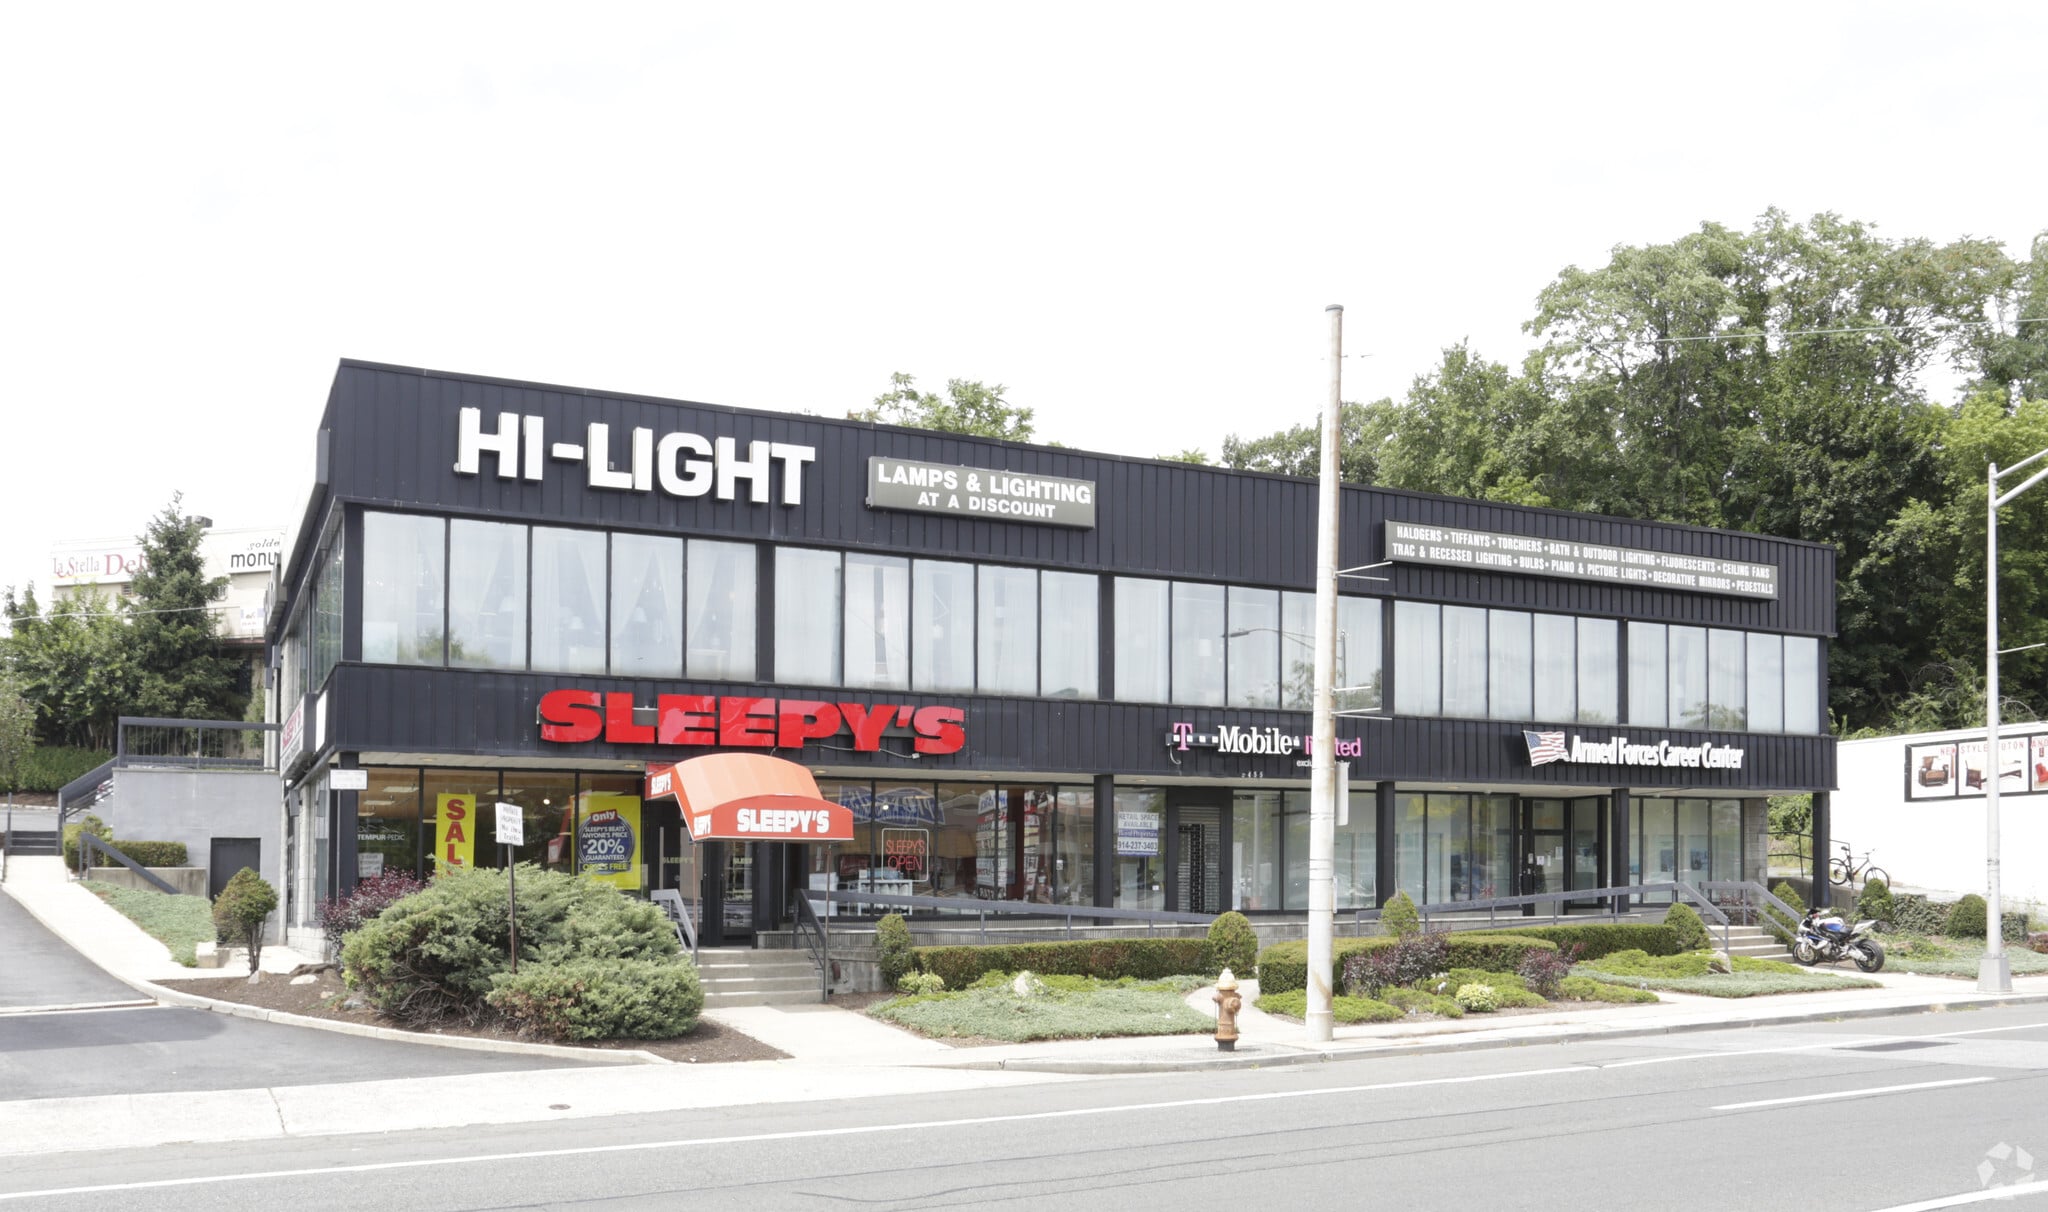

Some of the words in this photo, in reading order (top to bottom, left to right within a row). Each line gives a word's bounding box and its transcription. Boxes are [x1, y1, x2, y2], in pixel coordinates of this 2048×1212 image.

[458, 407, 816, 506] HI-LIGHT
[878, 463, 958, 490] LAMPS
[966, 473, 981, 492] &
[990, 475, 1092, 504] LIGHTING
[918, 491, 940, 507] AT
[948, 495, 960, 508] A
[968, 496, 1056, 518] DISCOUNT
[66, 556, 100, 577] Stella
[104, 553, 151, 576] Del
[1396, 525, 1442, 543] HALOGENS
[1450, 531, 1490, 547] TIFFANYS
[1497, 536, 1542, 553] TORCHIERS
[1549, 543, 1570, 556] BATH
[1574, 545, 1580, 557] &
[1583, 546, 1618, 562] OUTDOOR
[1621, 551, 1656, 566] LIGHTING
[1661, 555, 1716, 572] FLUORESCENTS
[1722, 563, 1750, 577] CEILING
[1751, 566, 1770, 579] FANS
[1392, 543, 1415, 556] TRAC
[1419, 545, 1426, 558] &
[1429, 546, 1472, 563] RECESSED
[1475, 551, 1512, 567] LIGHTING
[1519, 556, 1544, 570] BULBS
[1551, 559, 1575, 573] PIANO
[1578, 563, 1584, 574] &
[1587, 563, 1618, 578] PICTURE
[1621, 566, 1648, 581] LIGHTS
[1653, 570, 1696, 586] DECORATIVE
[1698, 575, 1731, 590] MIRRORS
[1736, 581, 1774, 595] PEDESTALS
[539, 689, 966, 755] SLEEPY'S
[1571, 735, 1618, 764] Armed
[1618, 737, 1659, 766] Forces
[1659, 739, 1701, 768] Career
[1702, 742, 1744, 769] Center
[1960, 743, 1988, 755] STYLE
[2001, 740, 2024, 751] UTON
[592, 811, 616, 822] Only
[736, 808, 830, 834] SLEEPY'S
[357, 833, 405, 841] TEMPUR-PEDIC
[445, 798, 466, 876] SAL
[587, 838, 625, 854] 20%
[885, 839, 925, 855] SLEEPY'S
[887, 855, 923, 871] OPEN
